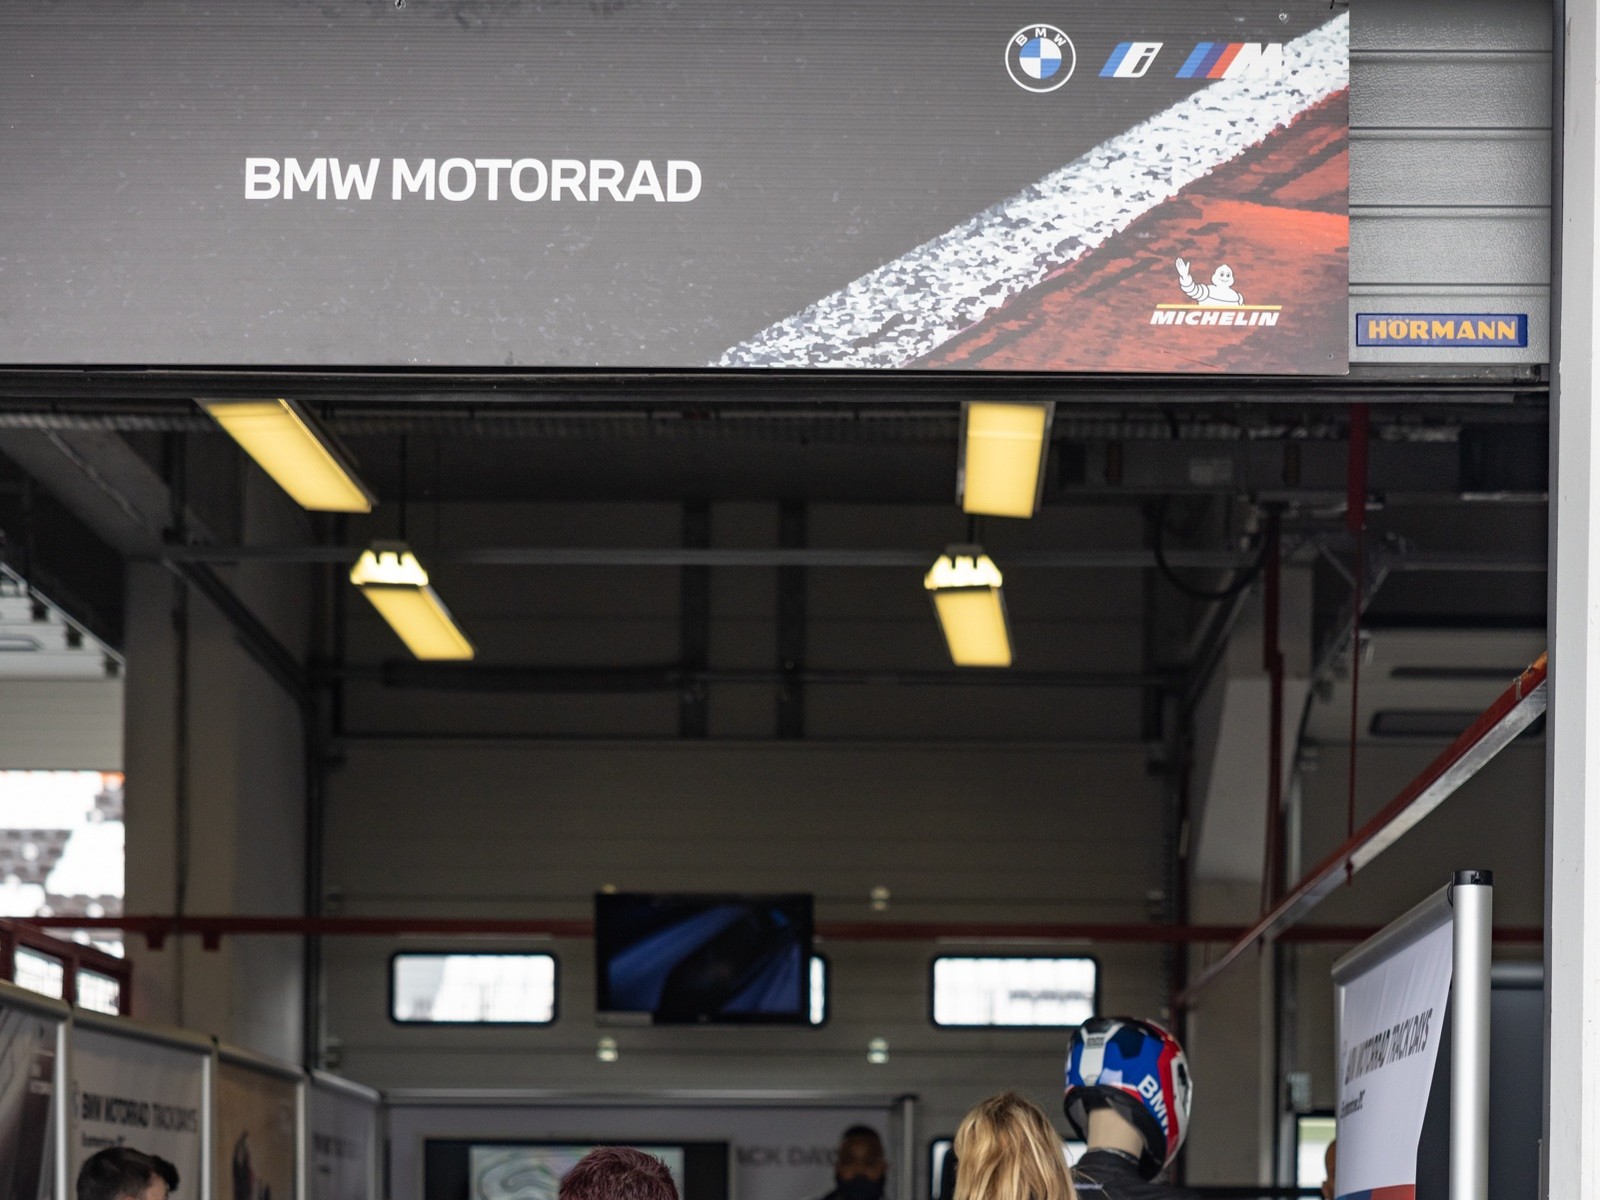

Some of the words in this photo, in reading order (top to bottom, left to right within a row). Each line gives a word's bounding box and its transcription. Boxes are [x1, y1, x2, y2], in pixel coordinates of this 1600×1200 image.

[244, 157, 380, 201] BMW
[392, 158, 703, 203] MOTORRAD
[1149, 309, 1279, 327] MICHELIN
[1368, 317, 1517, 341] HÖRMANN
